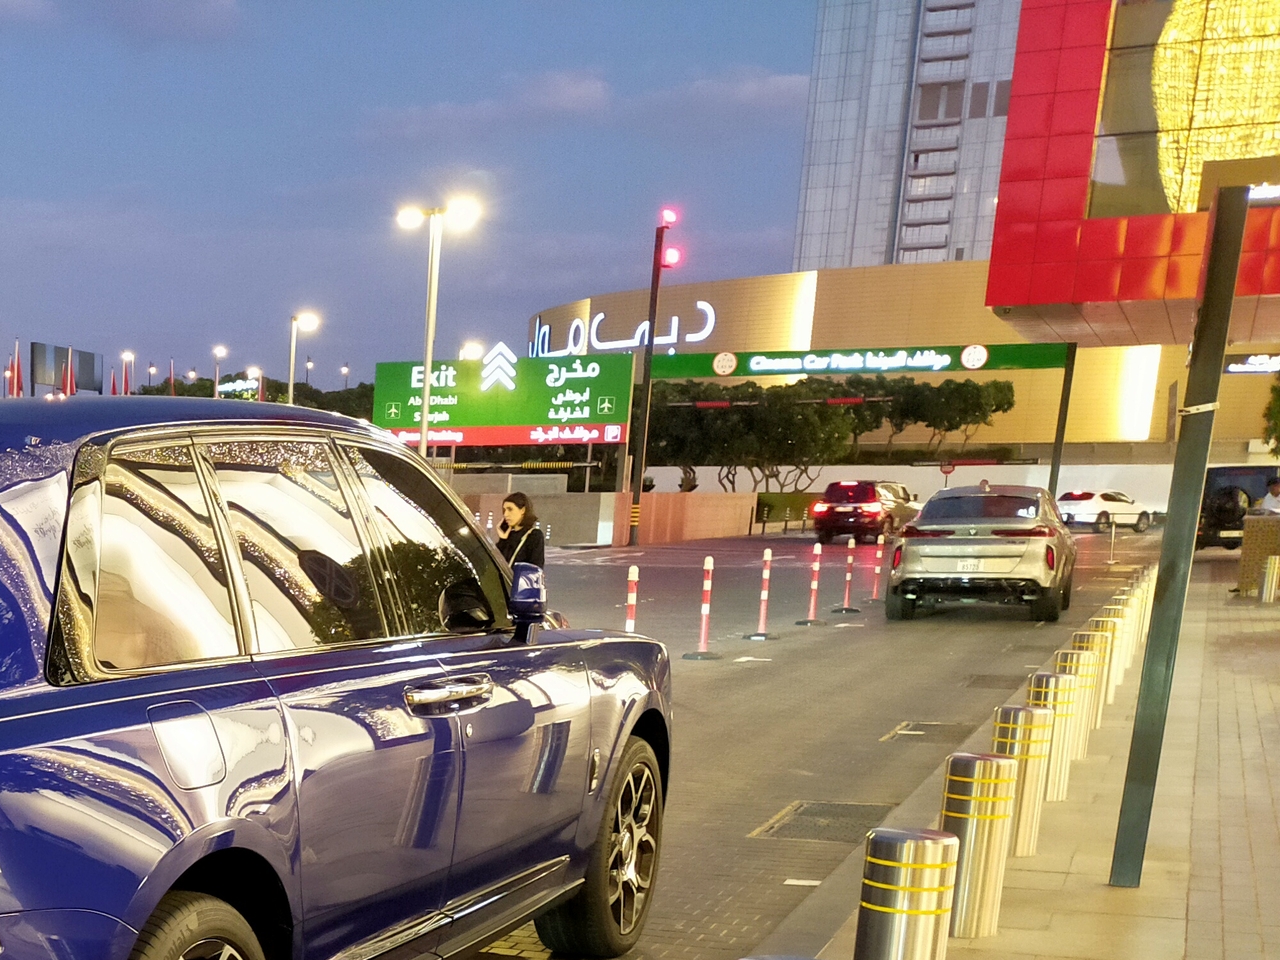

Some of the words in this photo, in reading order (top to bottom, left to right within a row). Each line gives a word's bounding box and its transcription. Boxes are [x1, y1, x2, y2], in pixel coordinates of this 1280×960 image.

[803, 354, 830, 369] Car
[411, 365, 457, 388] Exit
[545, 359, 600, 388] مخرج
[429, 395, 458, 406] Dhabi
